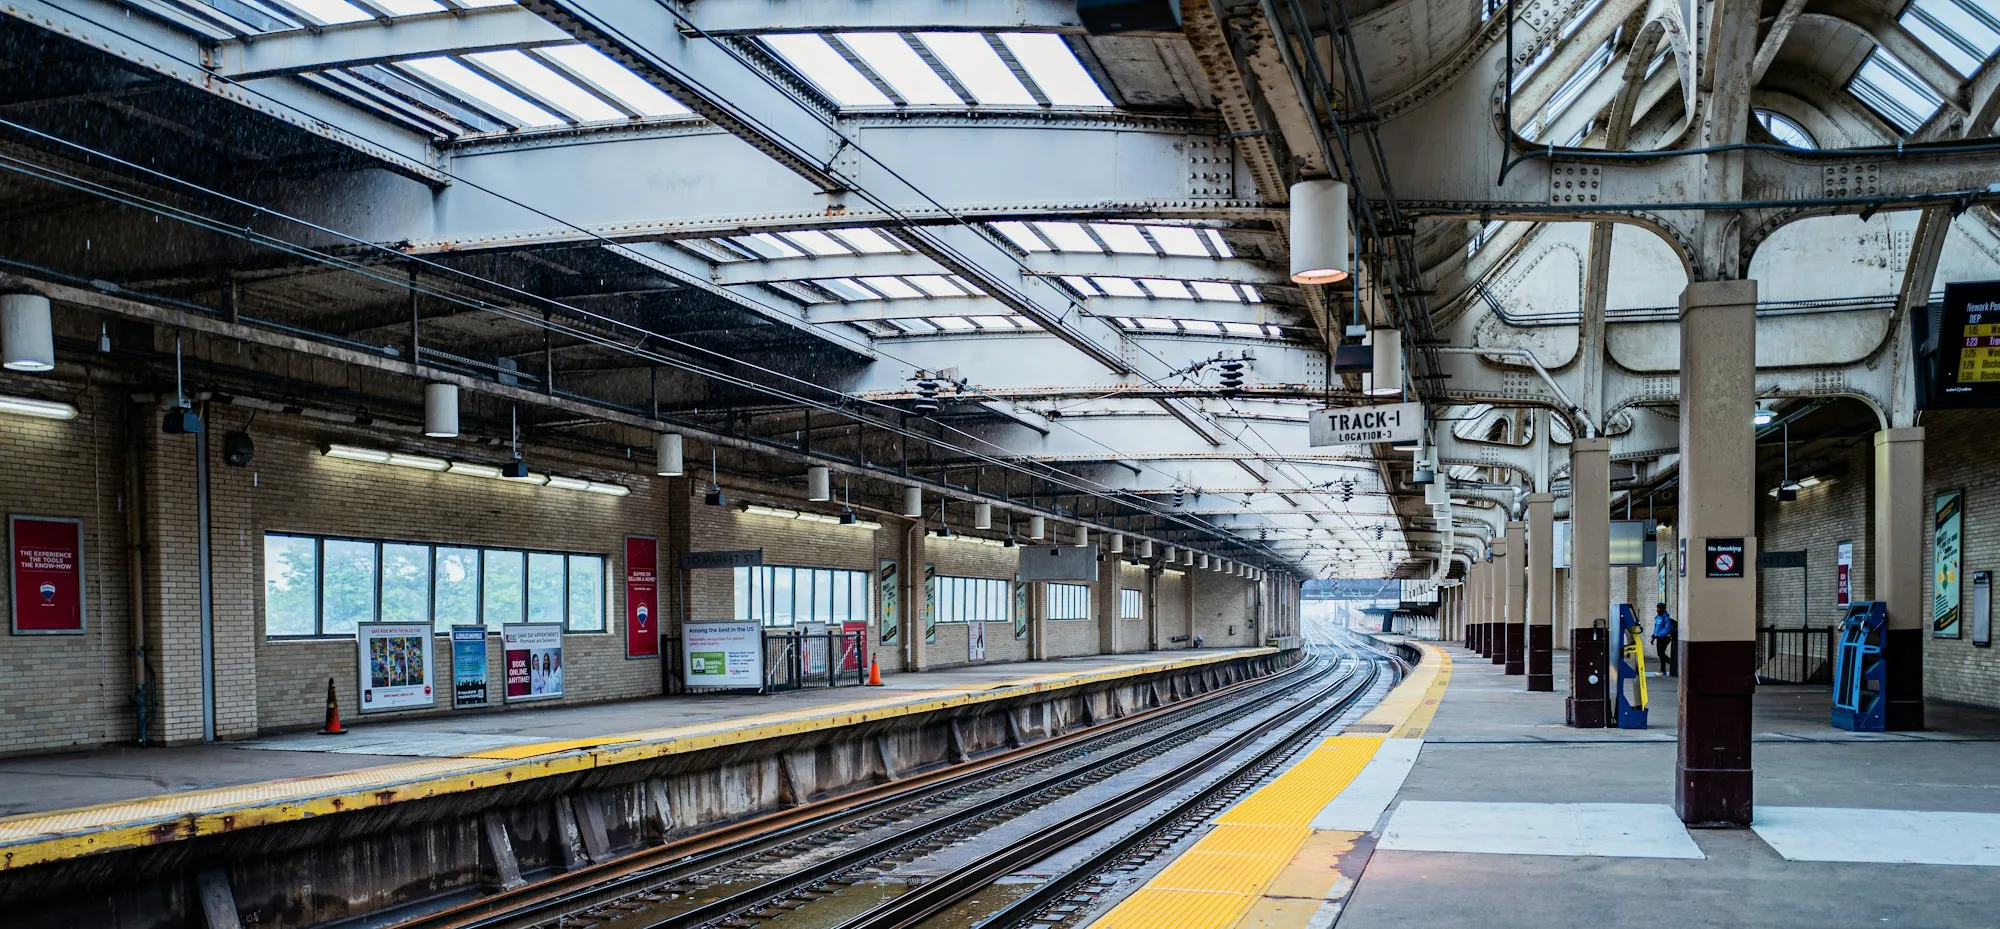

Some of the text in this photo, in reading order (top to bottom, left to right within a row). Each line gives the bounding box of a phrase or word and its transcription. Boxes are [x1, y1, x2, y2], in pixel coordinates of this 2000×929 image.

[1967, 303, 1989, 312] Newark
[1969, 314, 1982, 324] DEP
[1966, 337, 1978, 346] 1:23
[1965, 348, 1976, 358] 1:25
[1339, 430, 1392, 442] LOCATION-3
[687, 556, 699, 564] TO
[702, 555, 740, 564] MARKET
[508, 676, 530, 684] ANYTIME!
